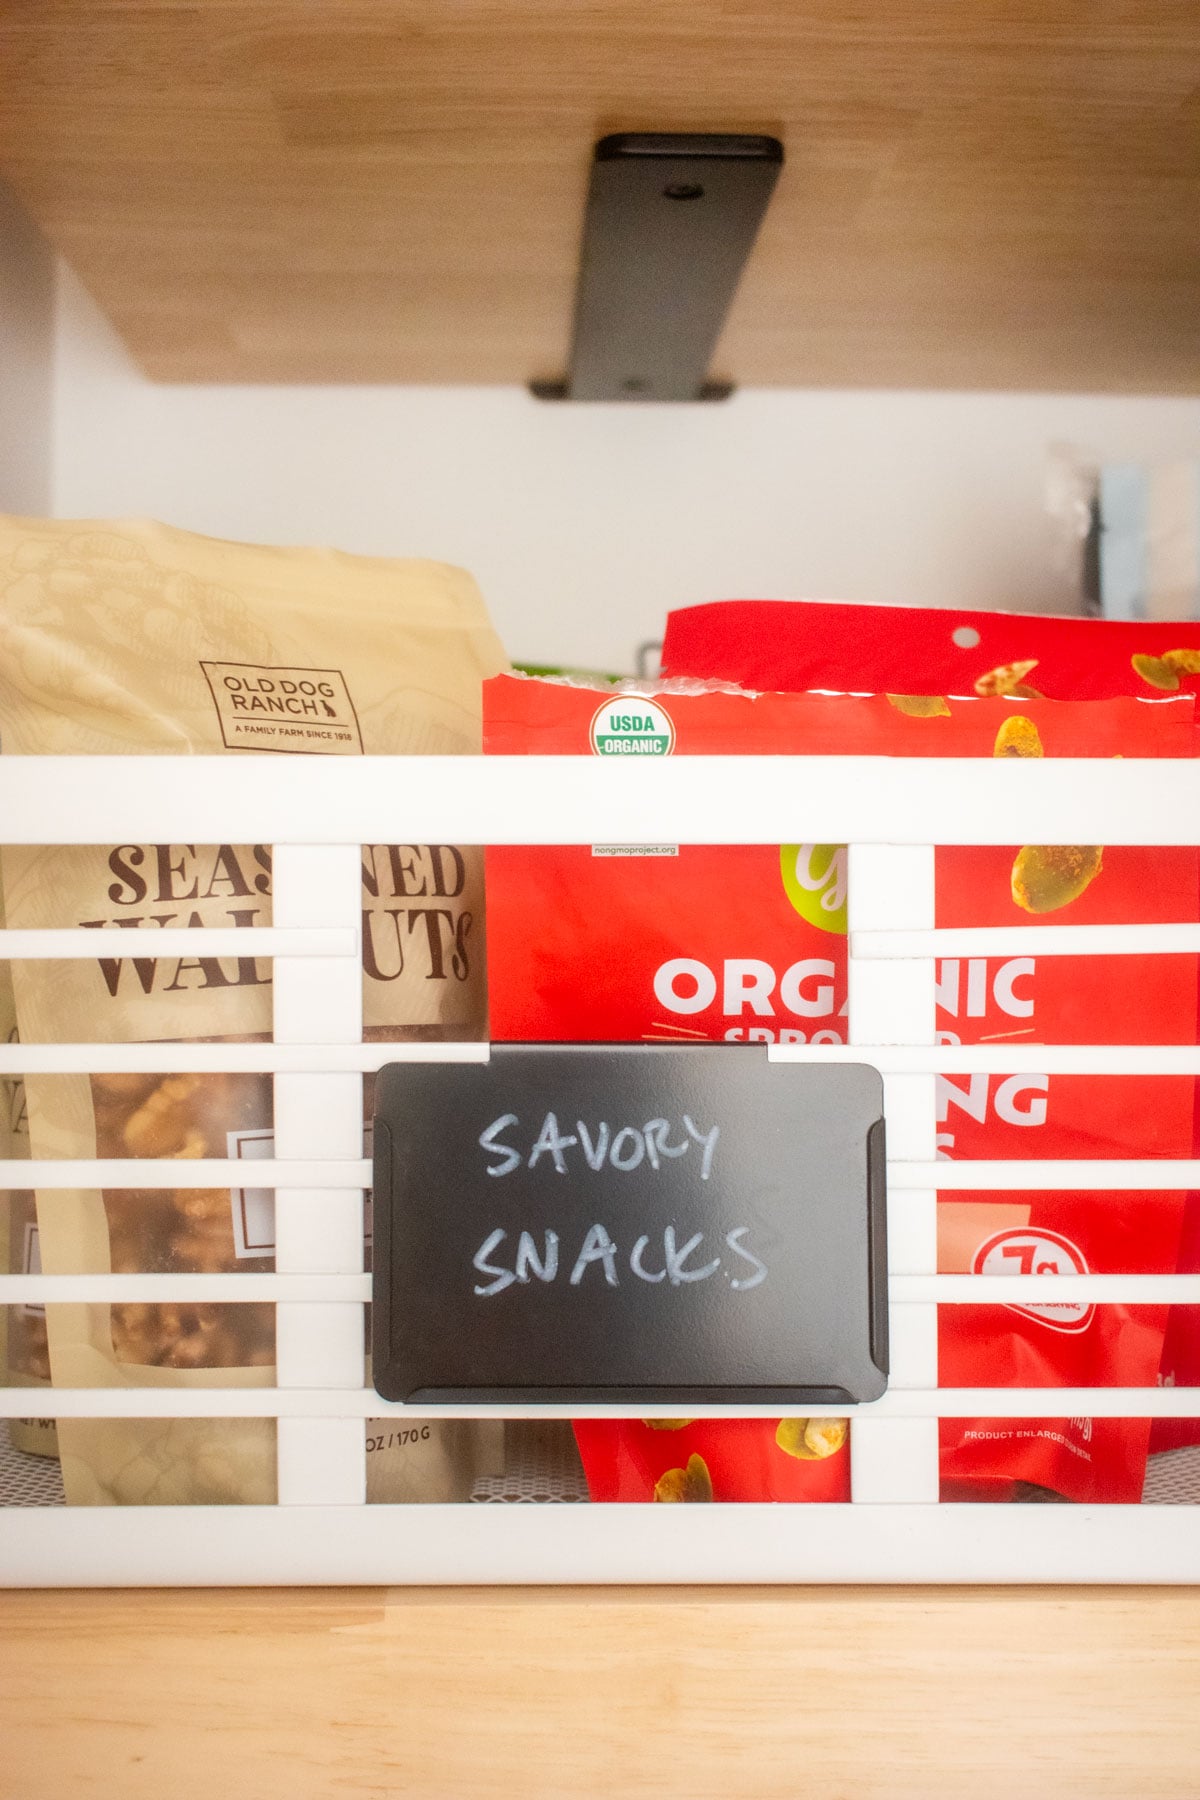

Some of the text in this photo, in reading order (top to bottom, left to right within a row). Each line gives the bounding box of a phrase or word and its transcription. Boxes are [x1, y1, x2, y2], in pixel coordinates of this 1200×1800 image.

[223, 676, 335, 698] OLD DOG
[231, 694, 319, 716] RANCH
[244, 725, 276, 735] FAMILY
[279, 728, 304, 737] FARM
[306, 730, 333, 739] SINCE
[610, 715, 655, 732] USDA
[604, 739, 662, 754] ORGANIC
[594, 846, 676, 856] nongmoproject.org
[107, 844, 466, 905] SEASNED
[79, 909, 473, 996] WALUTS
[653, 957, 1036, 1018] ORGNIC
[479, 1112, 720, 1180] SAVORY
[473, 1222, 768, 1296] SNACKS
[366, 1436, 384, 1452] OZ
[964, 1430, 1014, 1440] PRODUCT
